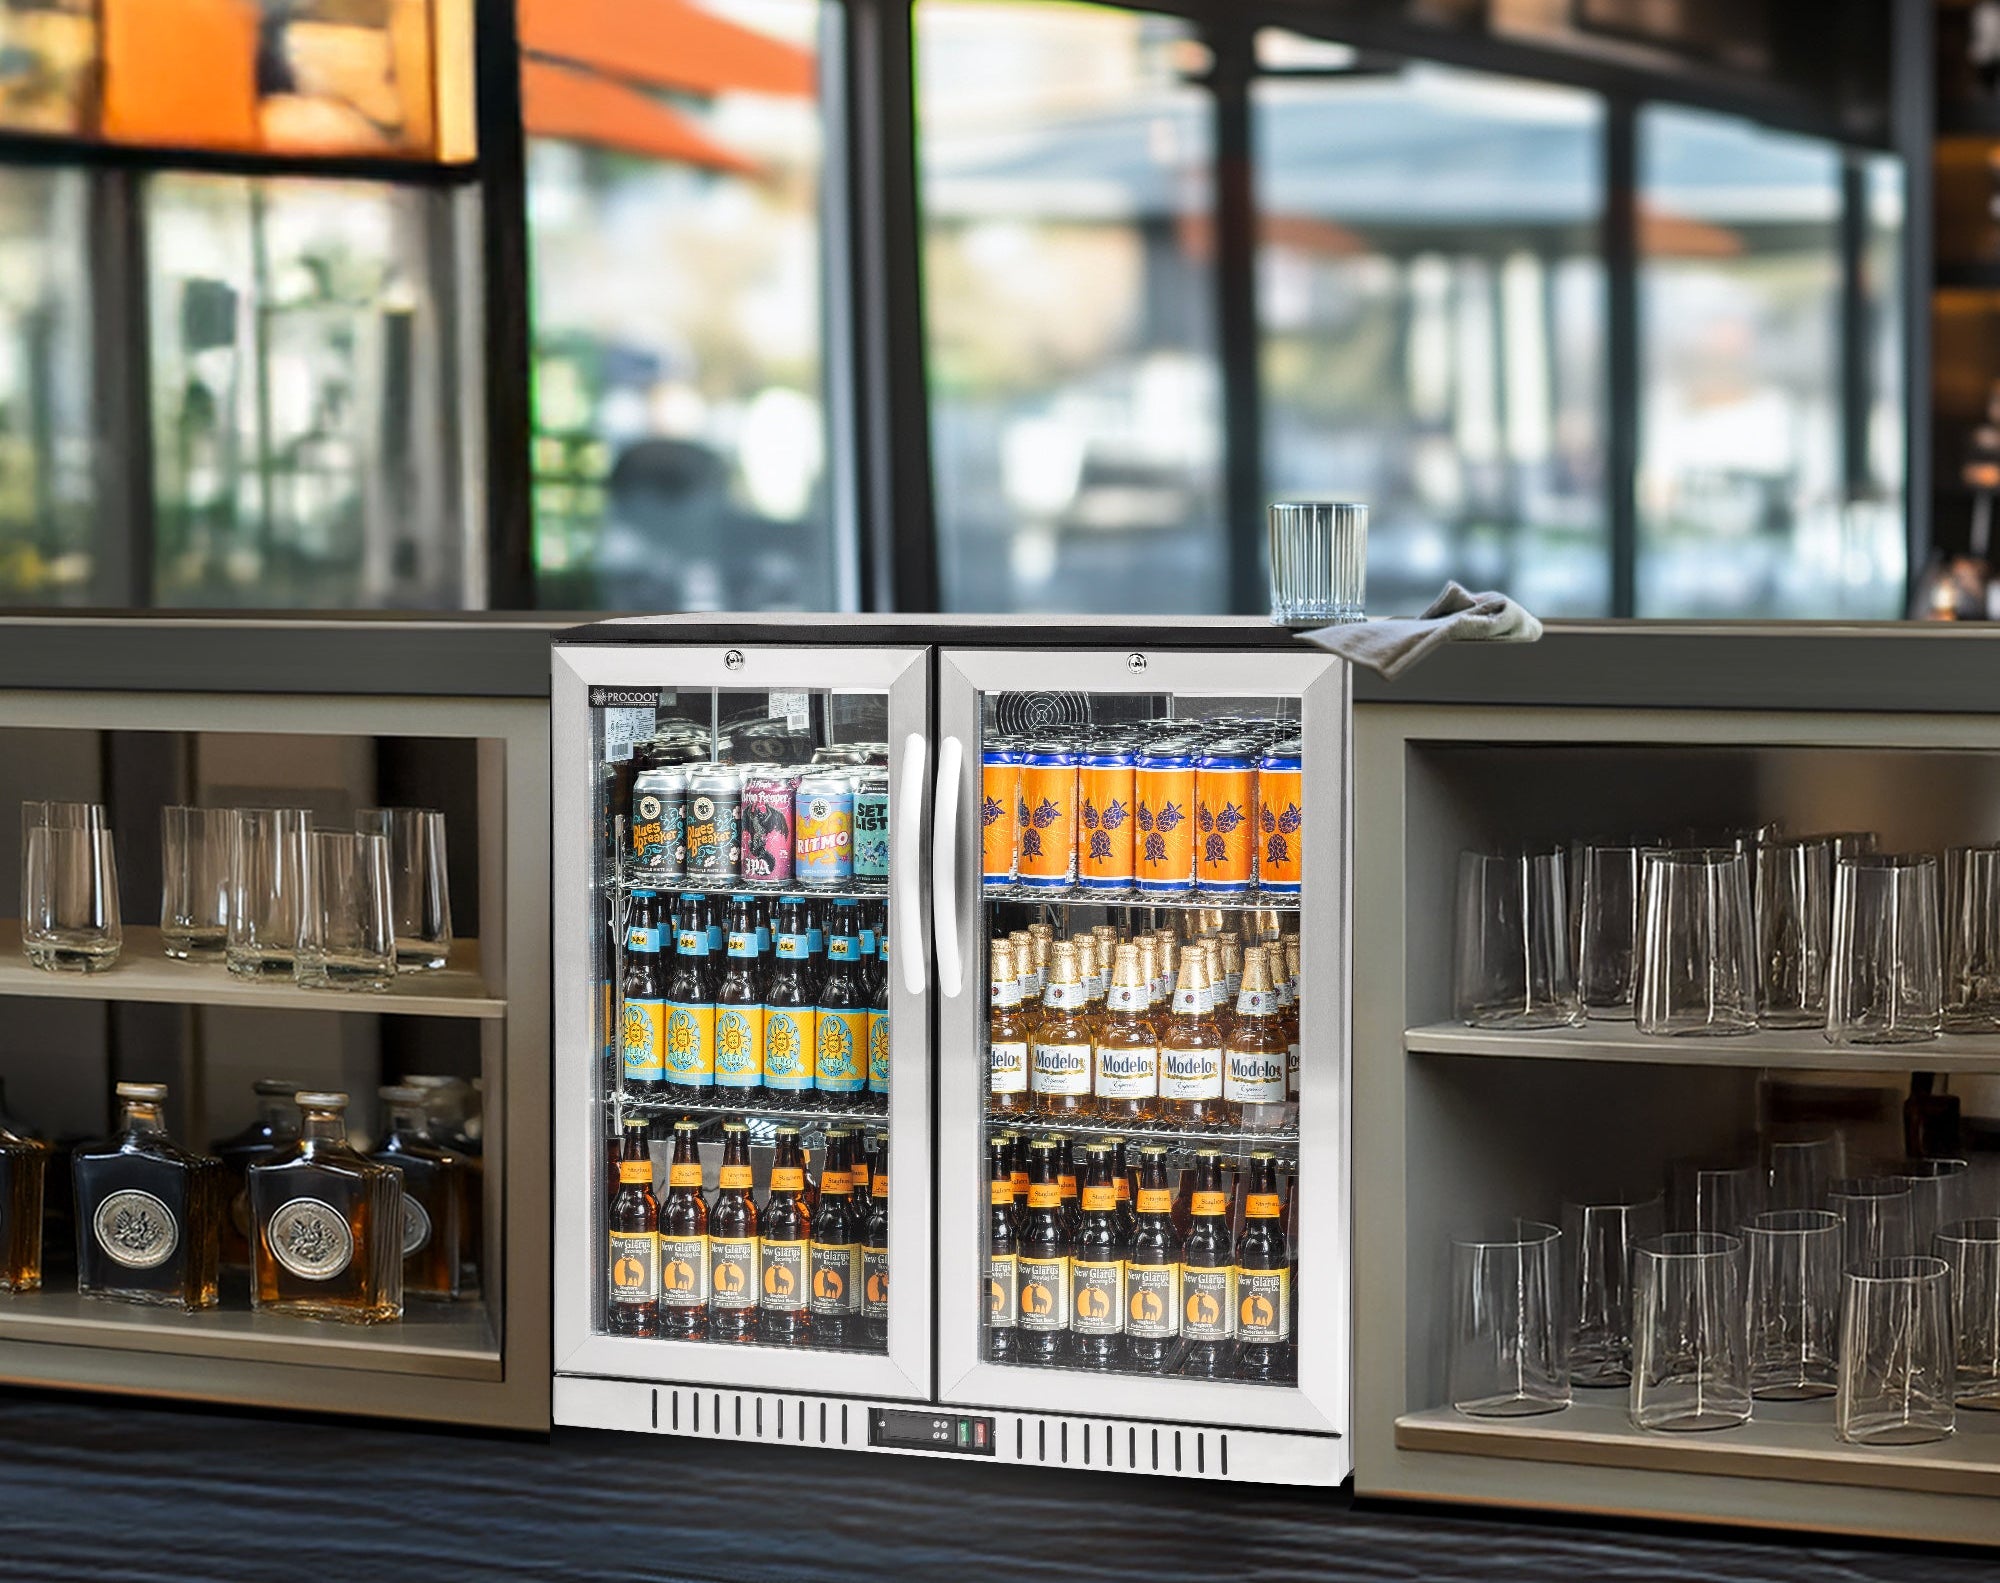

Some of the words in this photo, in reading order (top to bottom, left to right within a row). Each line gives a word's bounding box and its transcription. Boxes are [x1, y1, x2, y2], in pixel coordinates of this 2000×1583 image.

[857, 803, 887, 817] SET
[856, 816, 888, 831] LIST
[633, 822, 660, 845] Blues
[687, 823, 714, 846] Blues
[637, 831, 677, 856] Breaker
[691, 831, 731, 857] Breaker
[797, 831, 849, 854] RITMO
[991, 1051, 1015, 1067] delo
[1035, 1049, 1079, 1069] Modelo
[1103, 1054, 1147, 1073] Modelo
[1167, 1056, 1212, 1074] Modelo
[1231, 1058, 1276, 1077] Modelo
[611, 1238, 624, 1248] New
[661, 1241, 673, 1251] New
[711, 1243, 723, 1253] New
[763, 1246, 773, 1256] New
[812, 1249, 822, 1259] New
[864, 1253, 876, 1263] New
[1018, 1264, 1031, 1274] New
[1074, 1267, 1089, 1277] New
[1128, 1271, 1141, 1281] New
[1184, 1273, 1196, 1283] New
[1238, 1275, 1251, 1285] New
